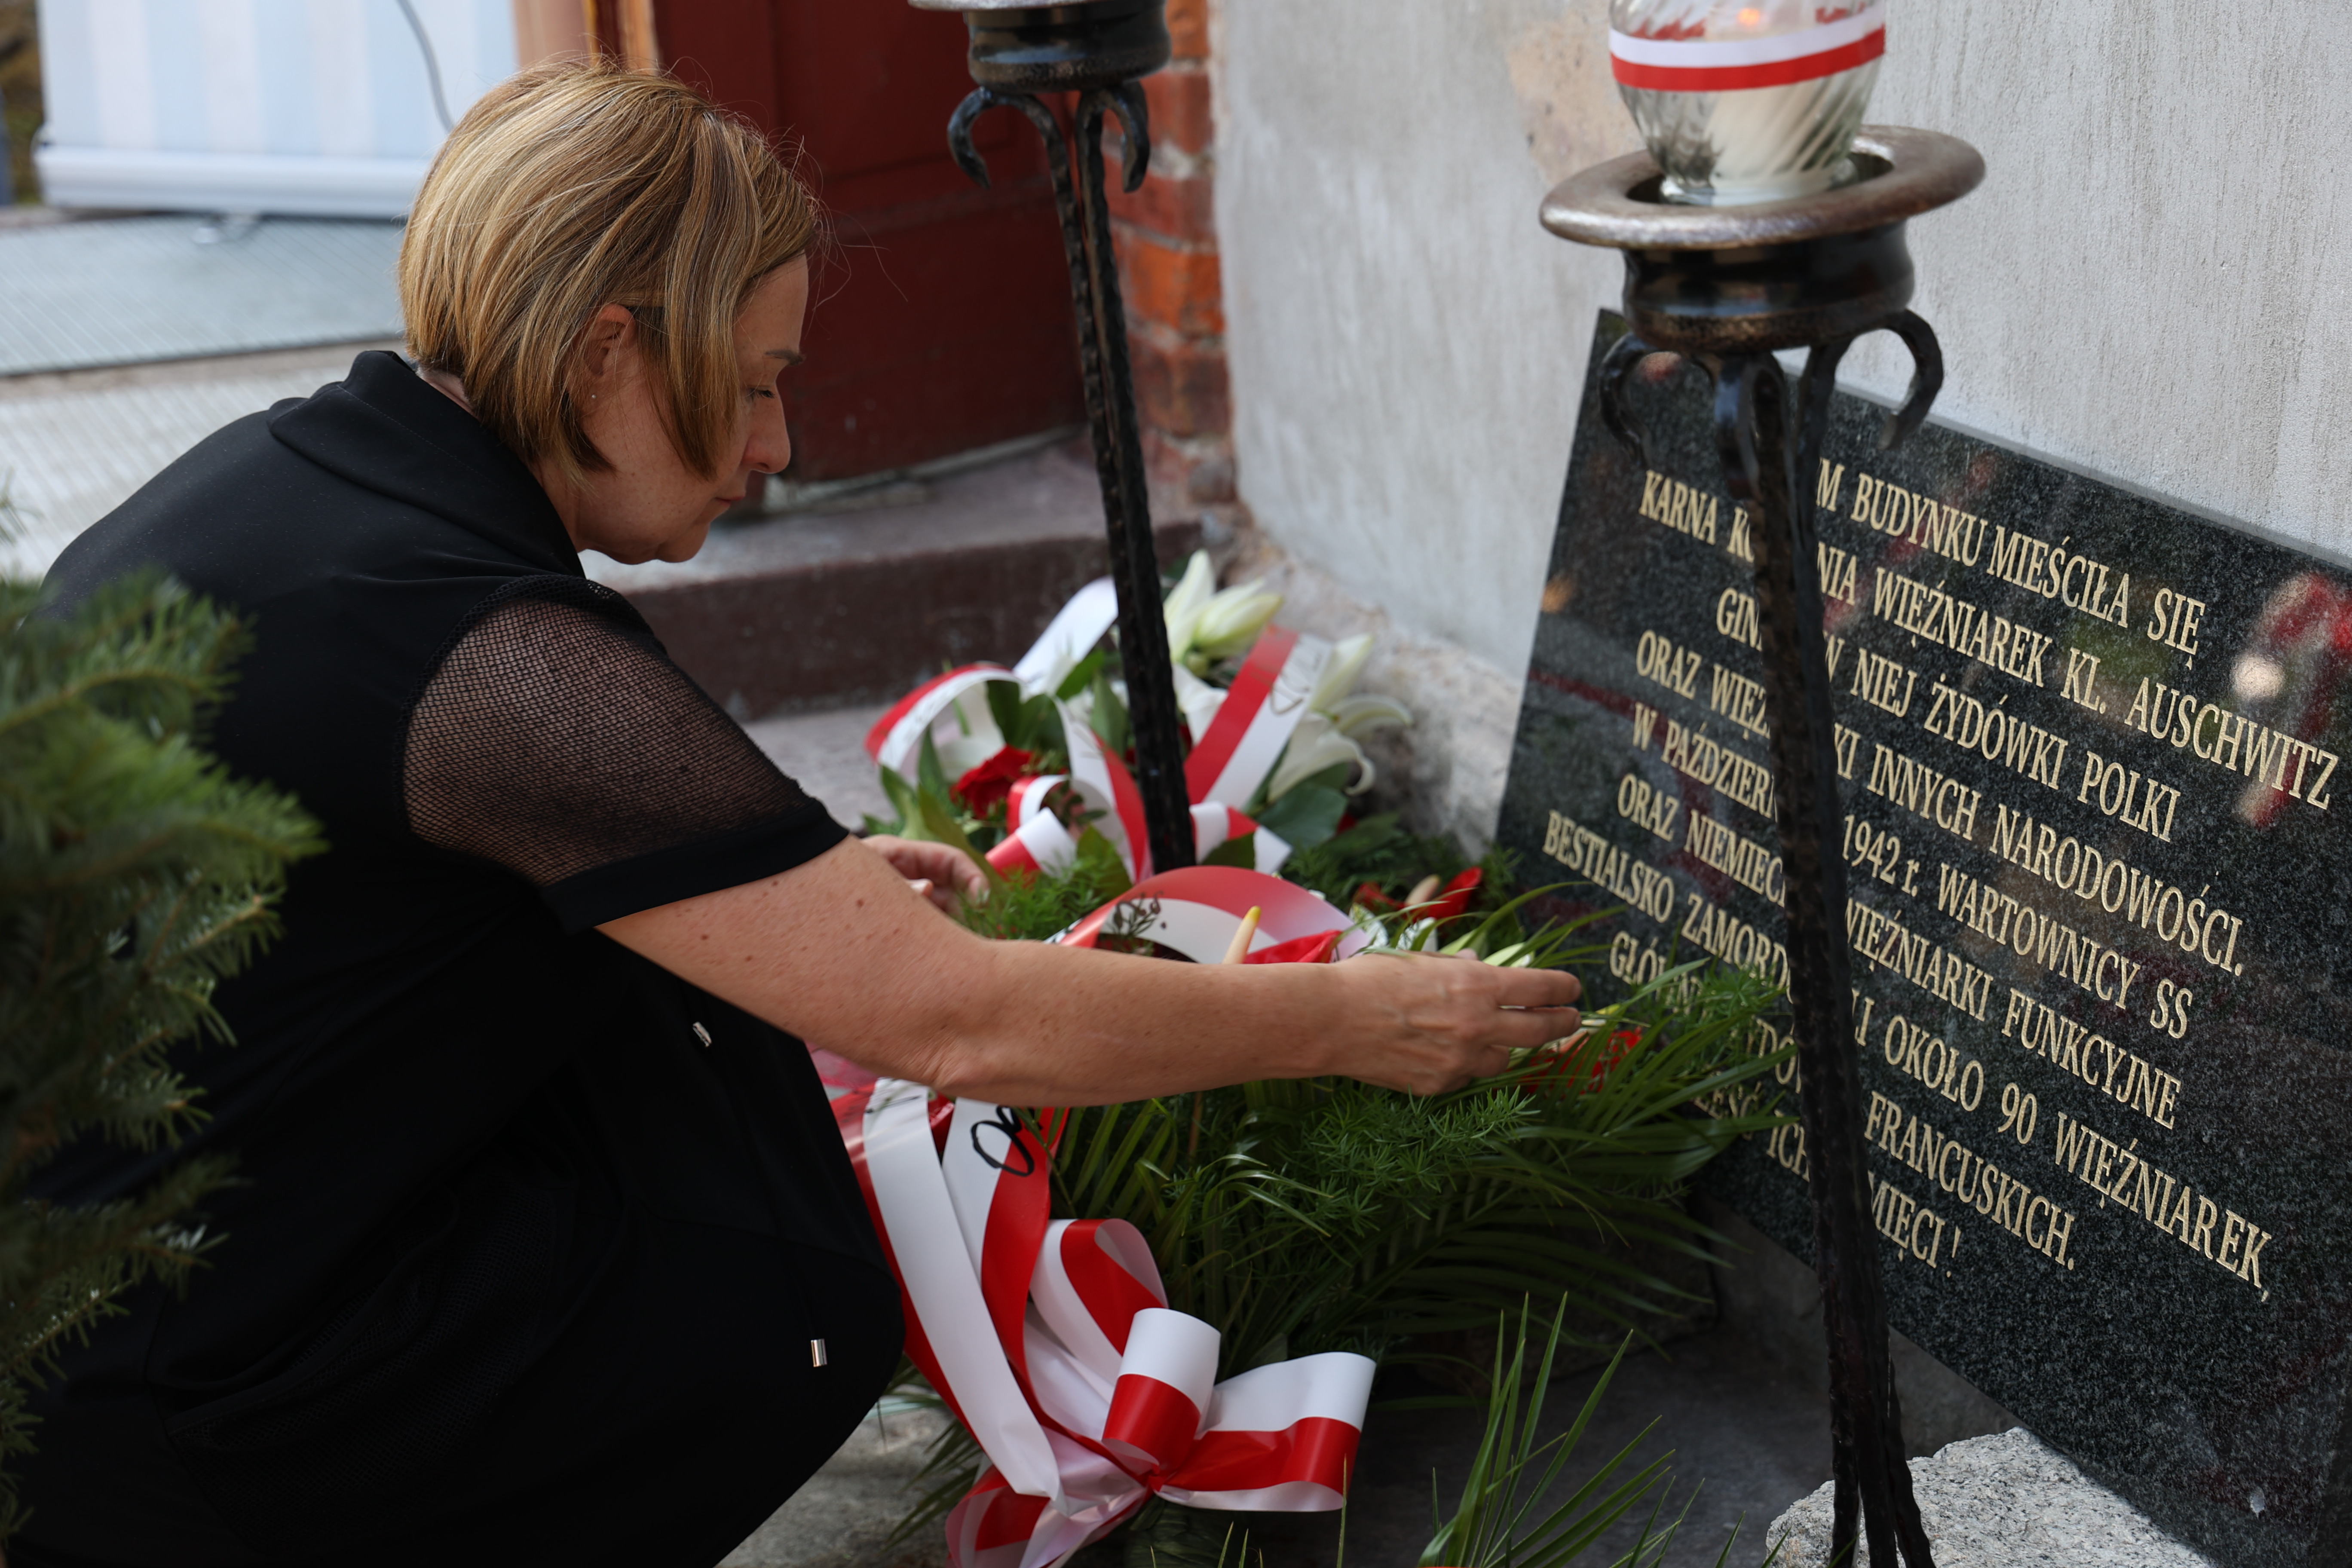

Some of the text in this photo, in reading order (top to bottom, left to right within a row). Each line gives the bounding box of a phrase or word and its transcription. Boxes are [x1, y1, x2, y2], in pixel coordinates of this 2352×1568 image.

[1639, 470, 1718, 545] KARNA
[1873, 566, 2052, 687] WIĘŹNIAREK
[2060, 647, 2106, 714] KL.
[2124, 677, 2339, 809] AUSCHWITZ
[1850, 473, 1988, 567] BUDYNKU
[1986, 525, 2129, 628] MIEŚCIŁA
[2147, 588, 2205, 670] SIĘ
[1633, 701, 2193, 1038] W PAŹDZIER 1942 r. WARTOWNICY SS
[1636, 630, 1701, 699] ORAZ
[1867, 743, 1981, 840] INNYCH
[1990, 803, 2243, 976] NARODOWOŚCI.
[1850, 647, 1917, 717] NIEJ
[1924, 673, 2068, 790] ŻYDÓWKI
[2077, 750, 2180, 842] POLKI
[1543, 809, 1675, 923] BESTIALSKO
[1885, 1015, 1984, 1112] OKOŁO
[1998, 1082, 2037, 1145] 90
[2055, 1111, 2272, 1302] WIĘŹNIAREK,
[1618, 773, 1678, 841] ORAZ
[1684, 809, 1785, 907] NIEMIEC
[2001, 988, 2181, 1130] FUNKCYJNE
[1865, 1091, 2074, 1271] FRANCUSKICH.
